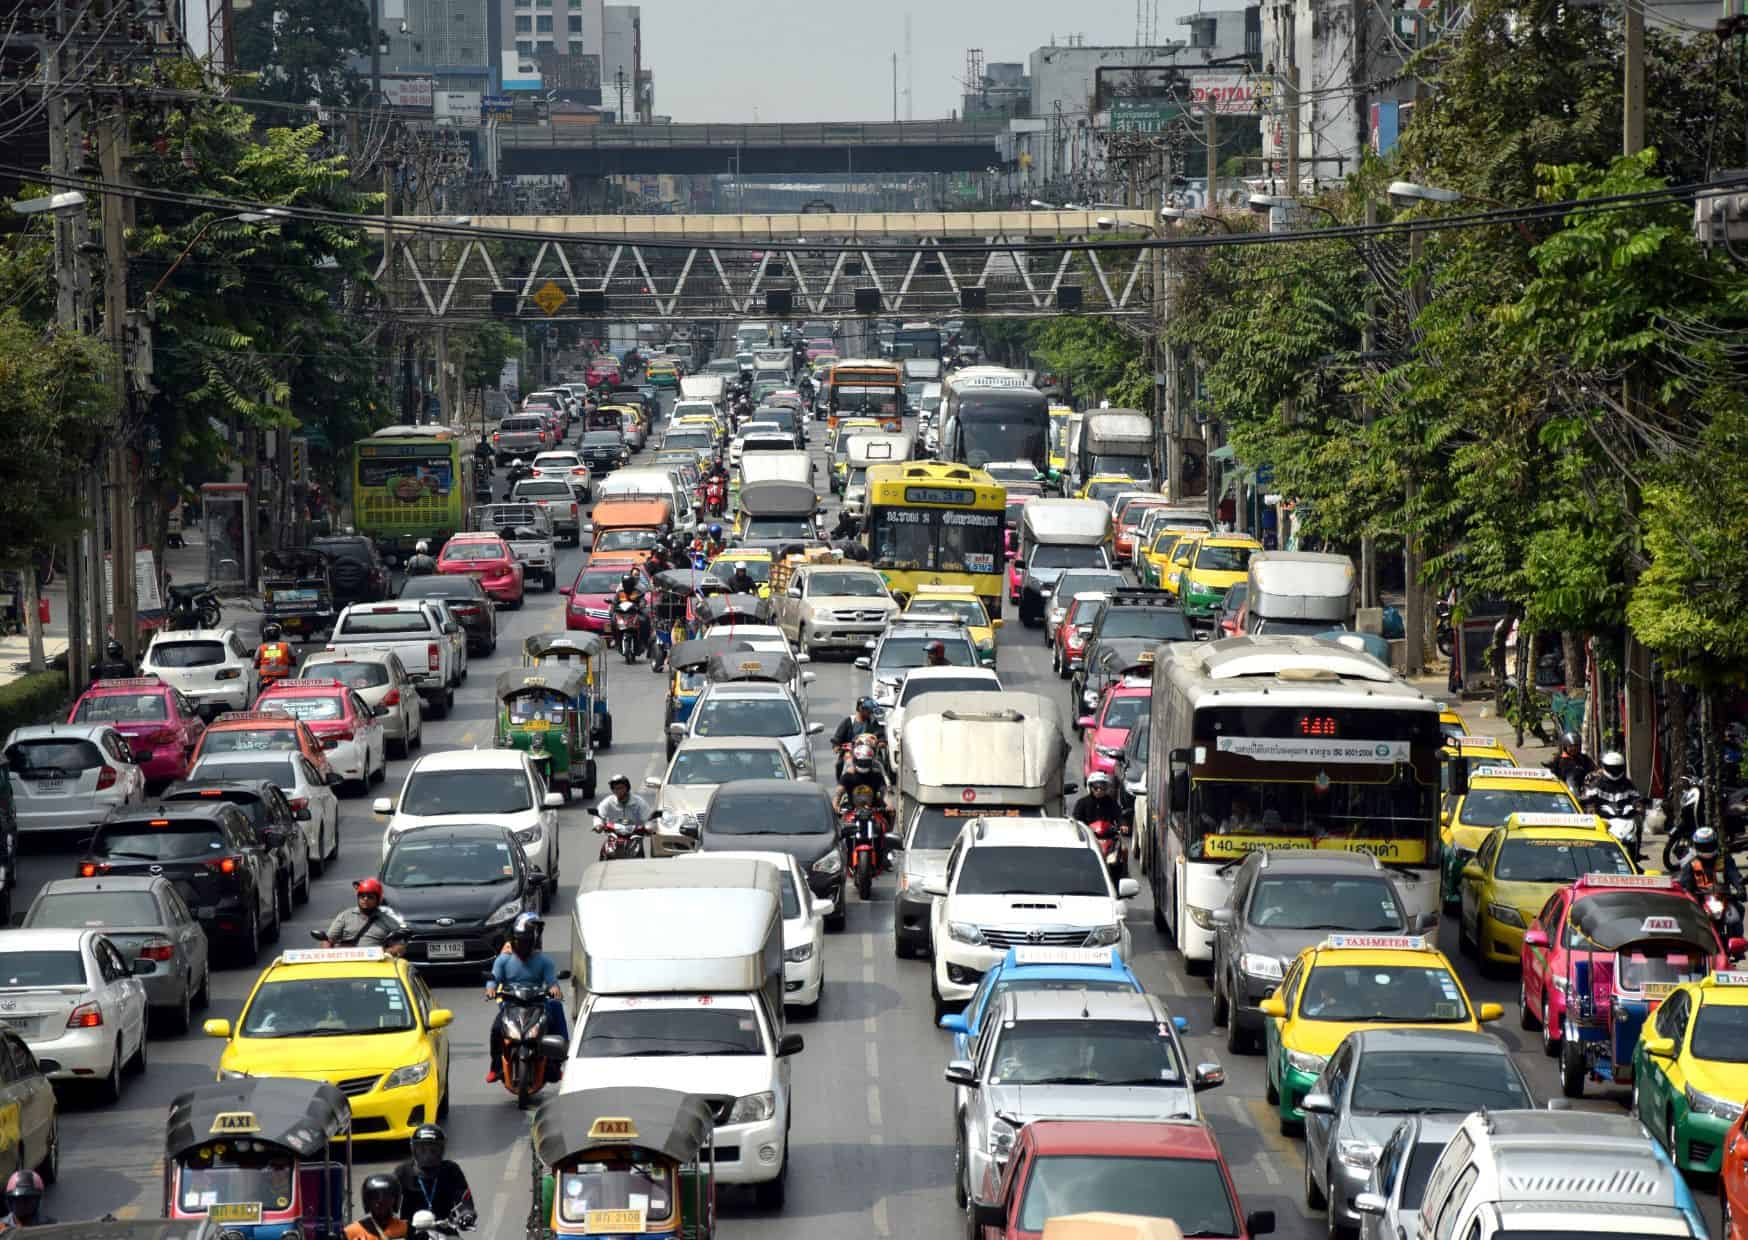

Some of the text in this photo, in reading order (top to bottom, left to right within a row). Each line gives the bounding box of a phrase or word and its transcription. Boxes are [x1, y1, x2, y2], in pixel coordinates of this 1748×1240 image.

[1300, 717, 1336, 735] 140
[1210, 839, 1233, 852] 140
[1650, 919, 1673, 929] TAXI
[222, 1116, 250, 1128] TAXI
[598, 1121, 628, 1134] TAXI
